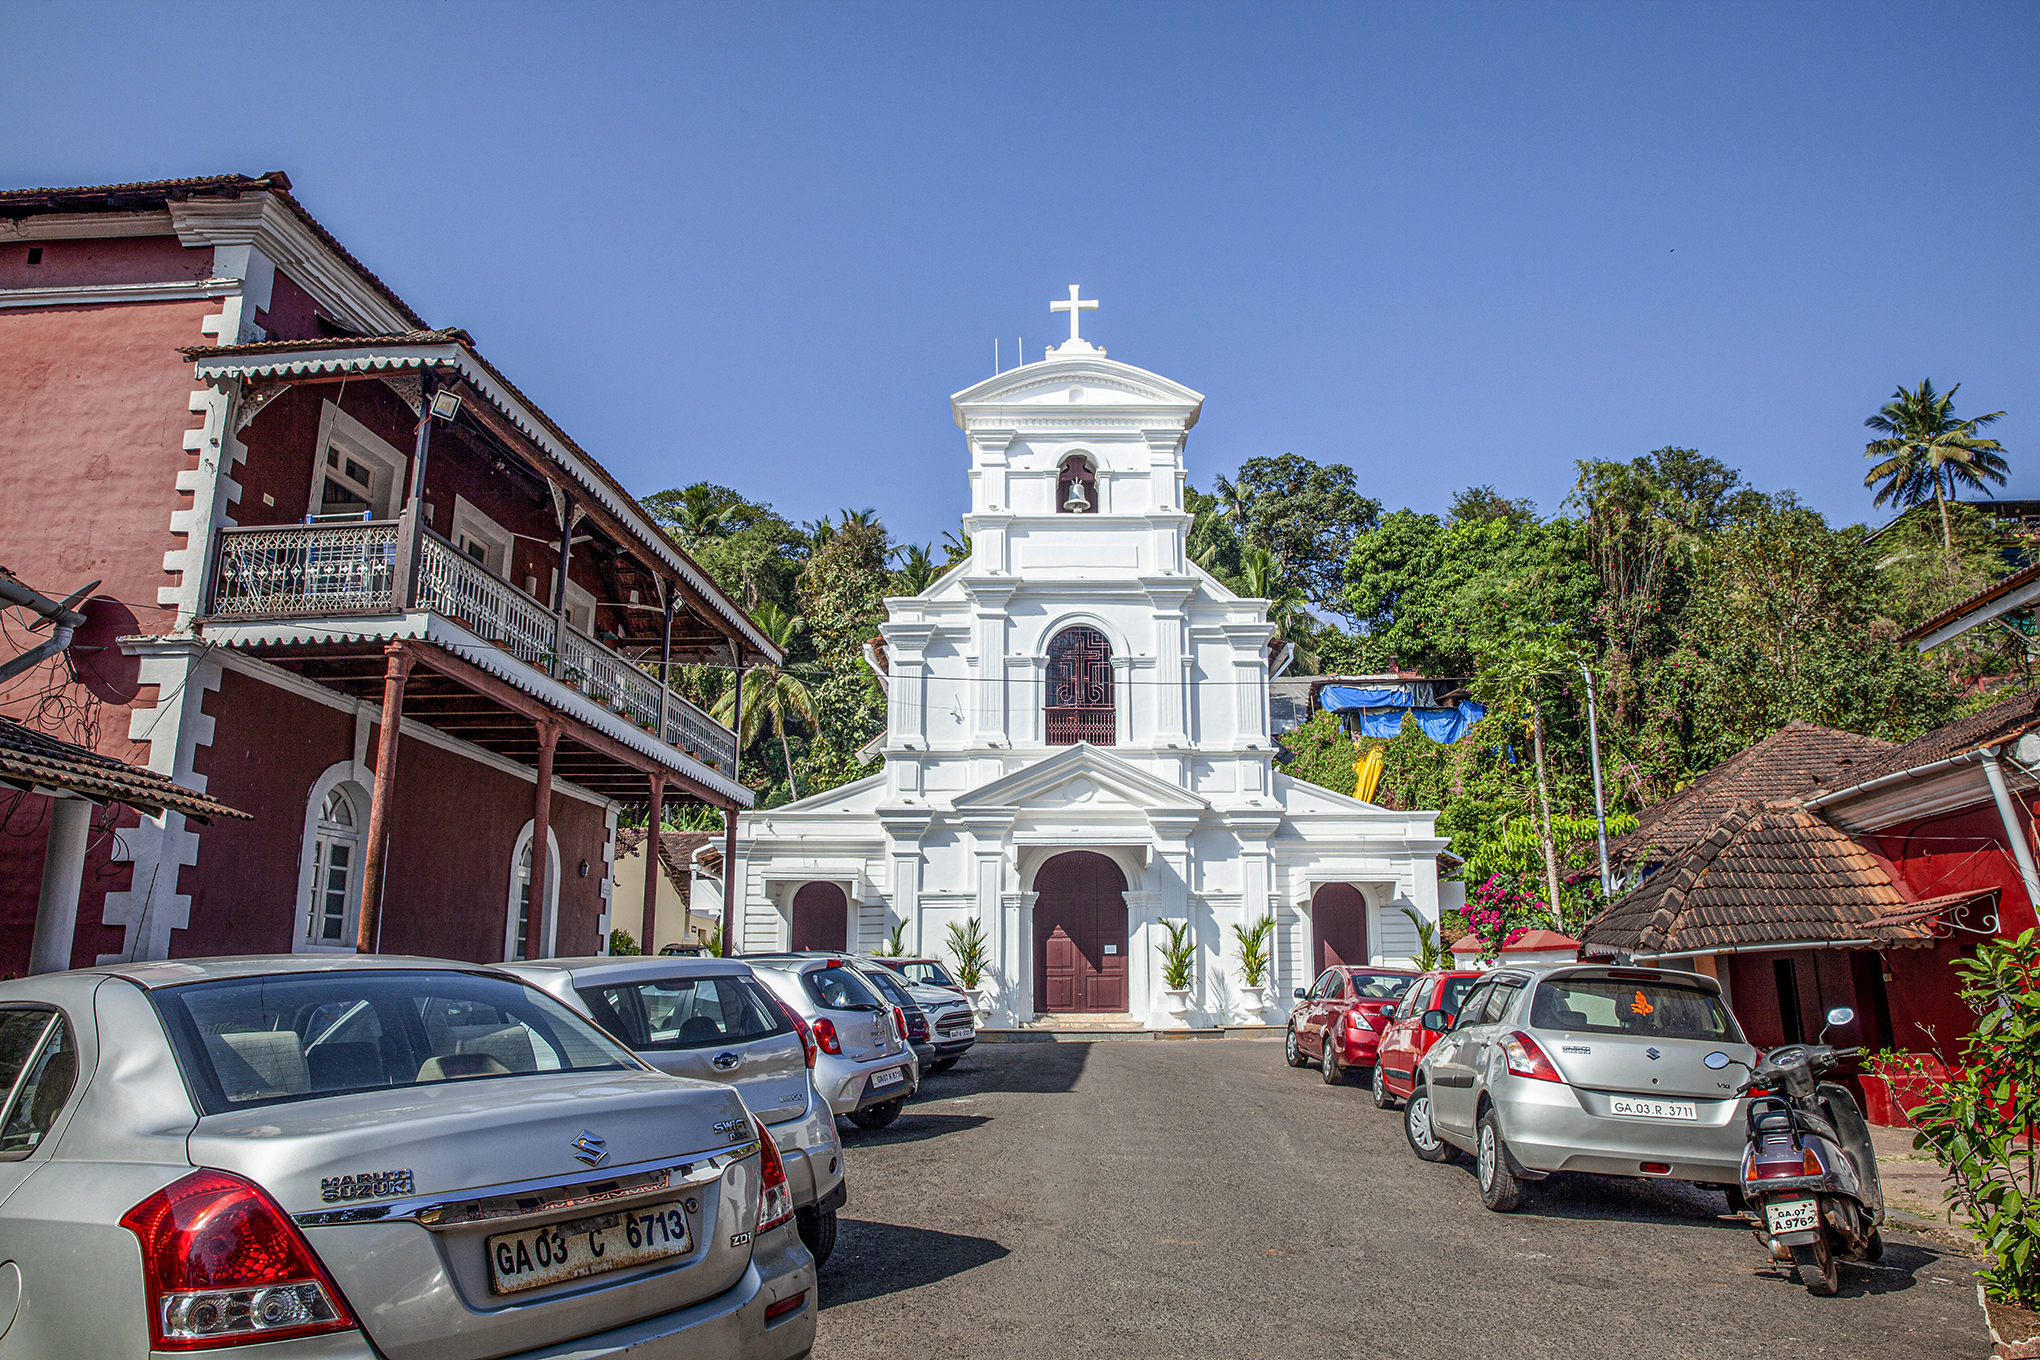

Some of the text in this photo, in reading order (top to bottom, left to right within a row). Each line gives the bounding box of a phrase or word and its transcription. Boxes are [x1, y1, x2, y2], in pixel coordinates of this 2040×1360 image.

[320, 1168, 412, 1189] MARUTI
[321, 1179, 413, 1203] SUZUKI
[1777, 1208, 1806, 1218] GA.07
[589, 1230, 605, 1258] C
[626, 1210, 685, 1248] 6713
